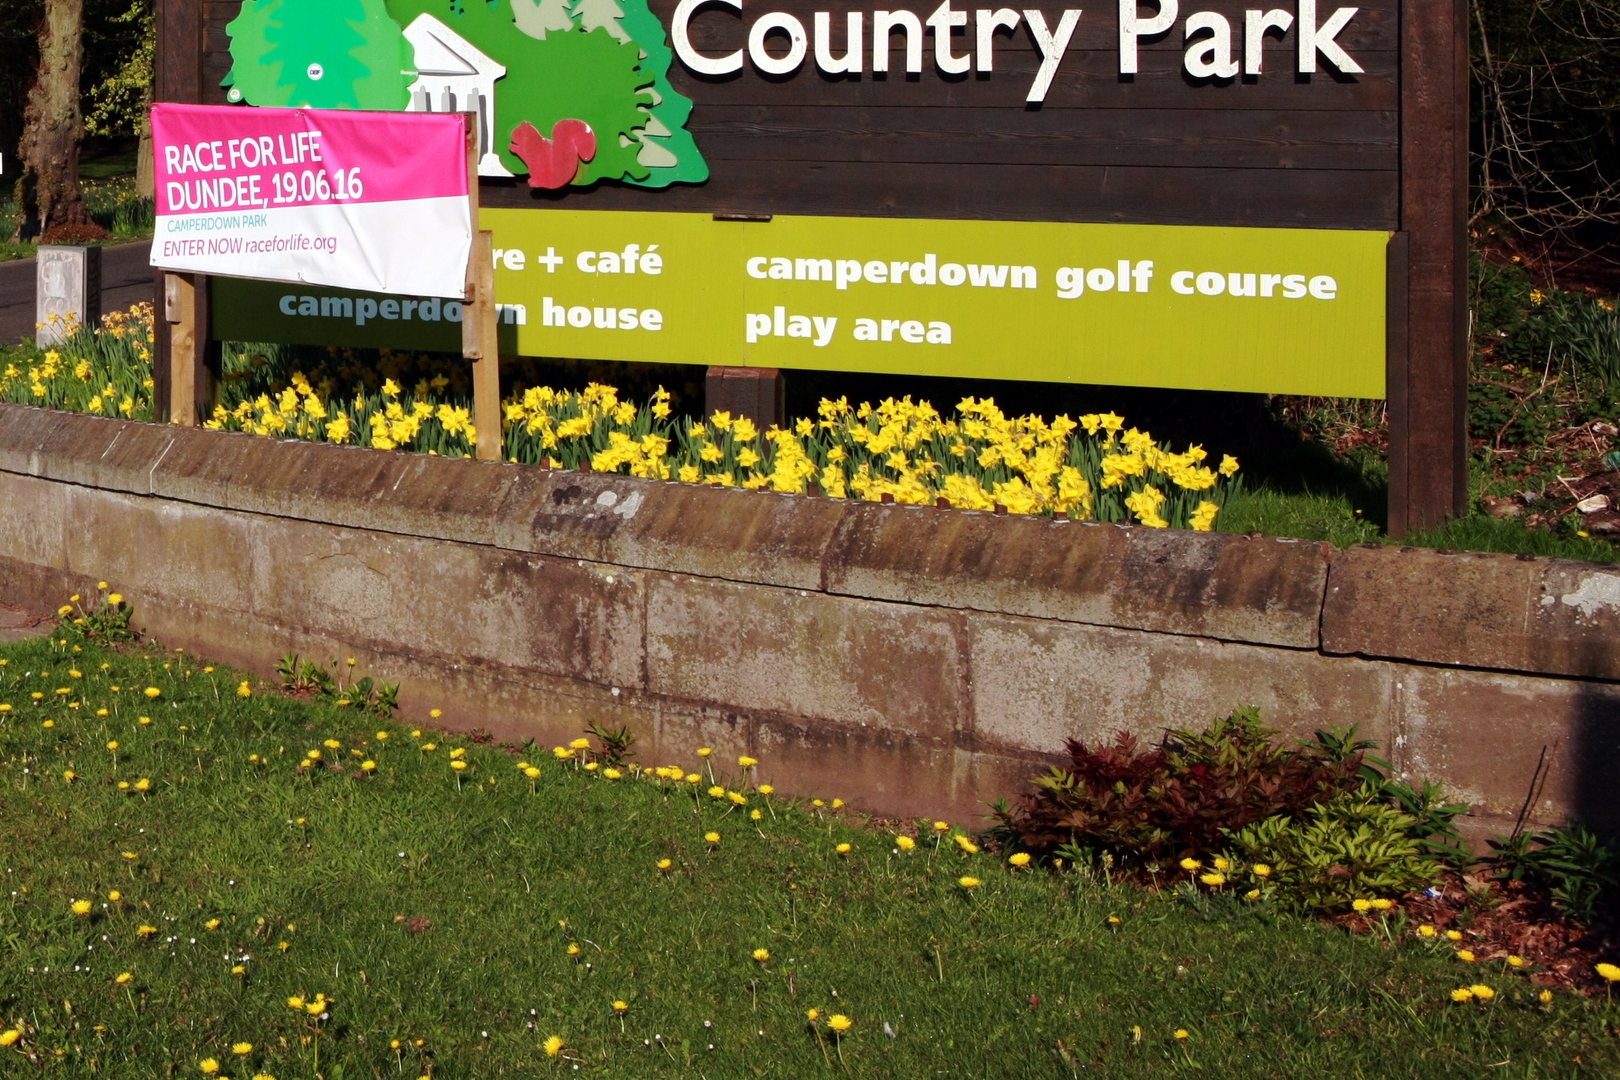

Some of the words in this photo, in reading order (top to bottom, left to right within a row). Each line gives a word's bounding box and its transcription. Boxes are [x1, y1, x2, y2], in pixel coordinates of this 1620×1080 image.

[164, 140, 226, 174] RACE
[228, 136, 277, 169] FOR
[279, 131, 322, 164] LIFE
[167, 175, 269, 211] DUNDEE,
[272, 167, 363, 203] 19.06.16
[167, 216, 241, 232] CAMPERDOWN
[242, 214, 268, 229] PARK
[164, 240, 205, 257] ENTER
[208, 237, 243, 255] NOW
[245, 233, 337, 255] raceforlife.org
[538, 247, 564, 273] +
[576, 244, 663, 275] café
[746, 253, 1037, 290] camperdown
[1055, 260, 1153, 298] golf
[1170, 269, 1337, 299] course
[542, 296, 663, 331] house
[746, 306, 837, 347] play
[853, 317, 952, 344] area
